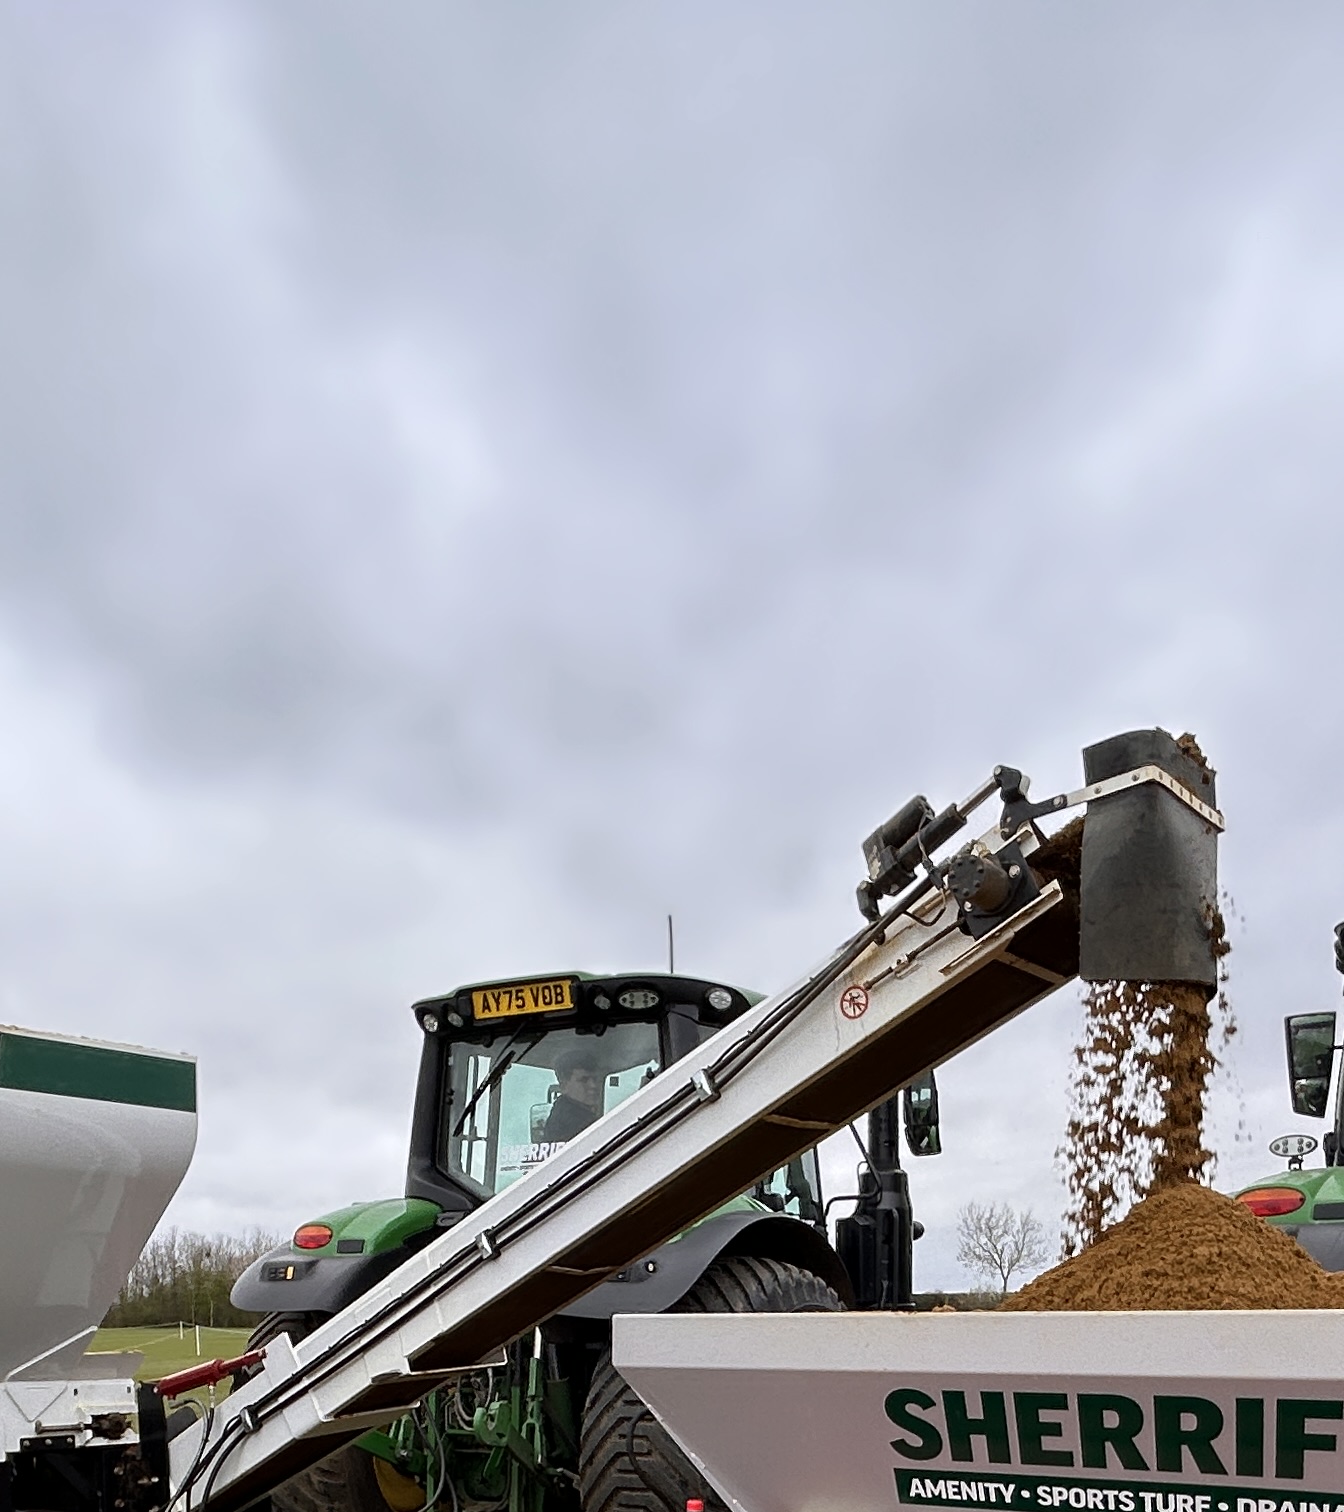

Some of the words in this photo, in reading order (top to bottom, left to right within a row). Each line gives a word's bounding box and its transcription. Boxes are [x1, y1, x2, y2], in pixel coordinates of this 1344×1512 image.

[481, 988, 526, 1014] AY75
[909, 1478, 1015, 1503] AMENITY
[1036, 1485, 1135, 1512] SPORTS
